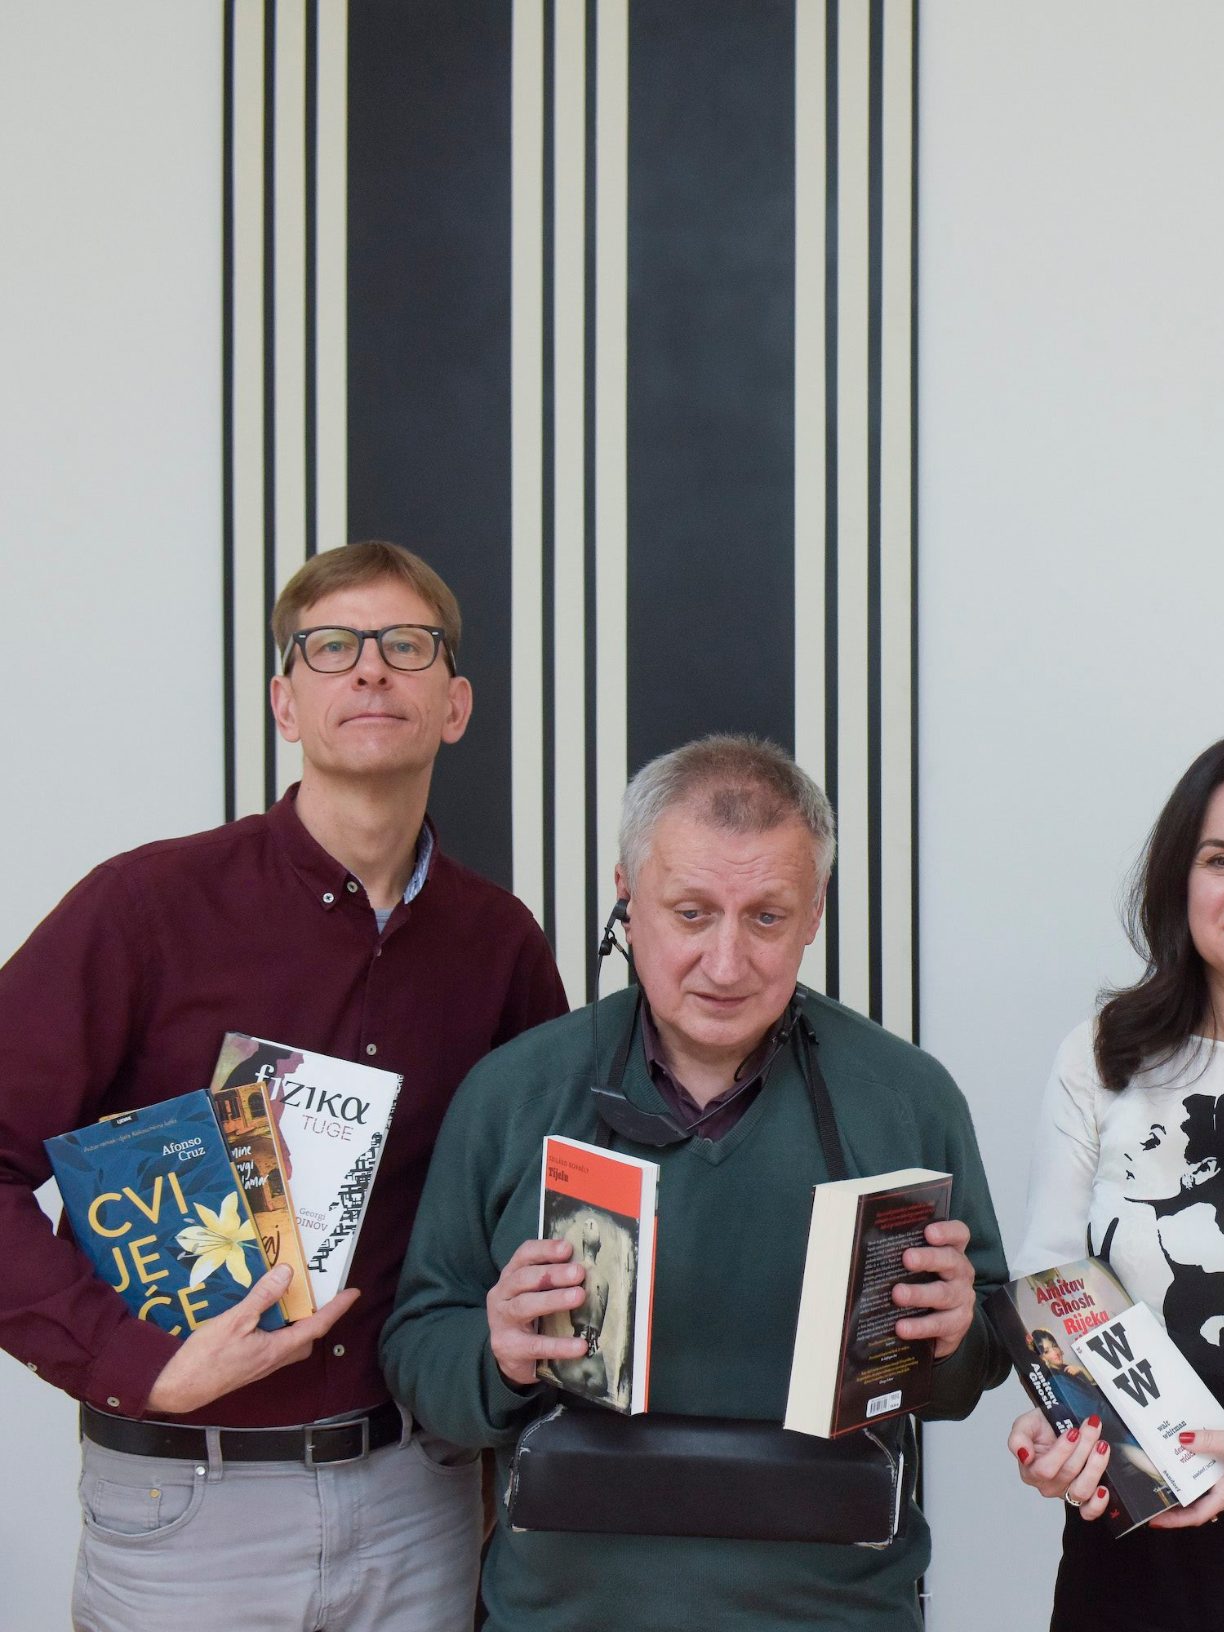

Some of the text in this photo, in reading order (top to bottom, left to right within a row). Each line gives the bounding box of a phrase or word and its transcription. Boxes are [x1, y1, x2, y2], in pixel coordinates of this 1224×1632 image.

[302, 1115, 354, 1141] TUGE
[162, 1137, 202, 1156] Afonso
[178, 1147, 206, 1161] Cruz
[88, 1172, 189, 1239] CVI
[300, 1207, 326, 1222] Georgi
[112, 1235, 169, 1293] JE
[1036, 1277, 1085, 1304] Amitav
[1050, 1292, 1096, 1318] Ghosh
[1063, 1309, 1110, 1336] Rijeka
[1086, 1322, 1136, 1370] W
[1029, 1372, 1053, 1410] Ghosh
[1030, 1363, 1060, 1406] Amitav
[1112, 1358, 1161, 1408] W
[1157, 1420, 1171, 1432] walt
[1162, 1420, 1188, 1440] whitman
